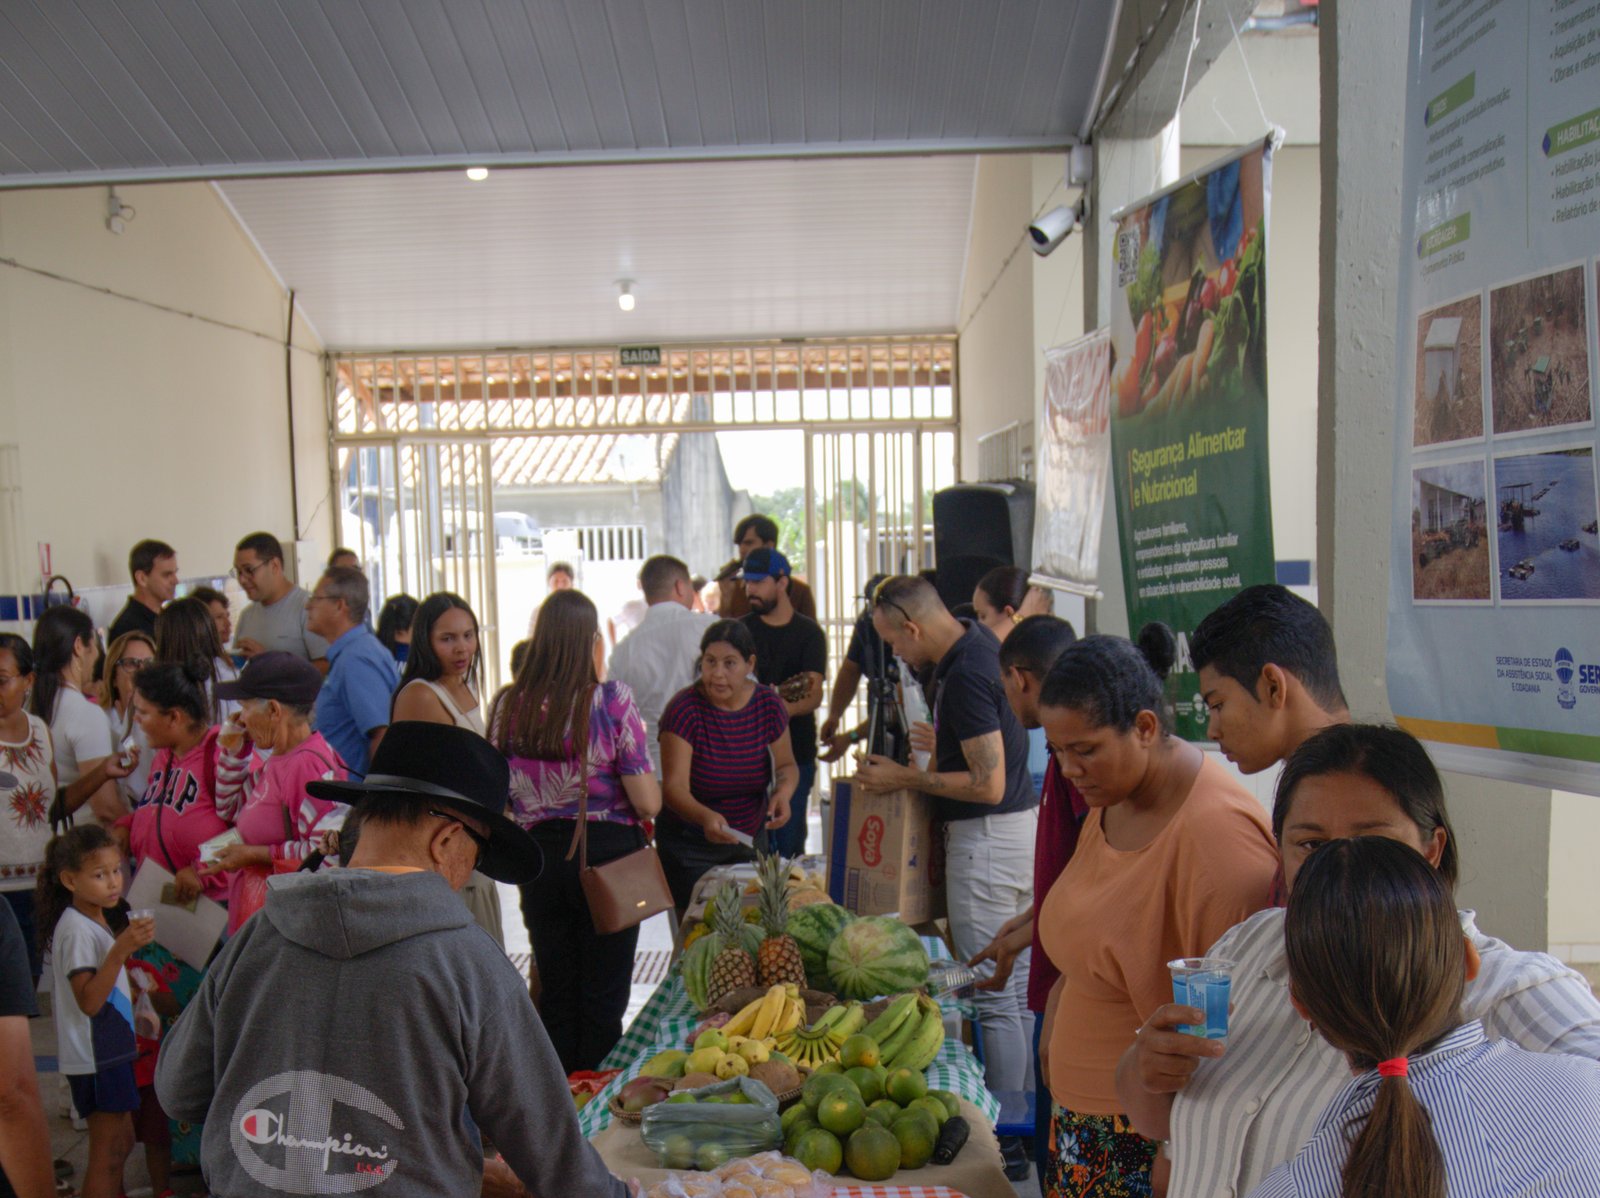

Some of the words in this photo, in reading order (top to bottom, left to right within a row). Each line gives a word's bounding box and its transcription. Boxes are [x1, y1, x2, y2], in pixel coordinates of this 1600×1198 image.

[1554, 62, 1574, 83] Obras
[1555, 153, 1593, 177] Habilitação
[1556, 175, 1594, 199] Habilitação
[1556, 200, 1588, 223] Relatório
[1131, 441, 1185, 477] Segurança
[1187, 426, 1247, 460] Alimentar
[1134, 490, 1141, 507] e
[1142, 469, 1198, 505] Nutricional
[1182, 537, 1216, 556] agricultura
[1216, 532, 1239, 548] familiar
[1200, 556, 1229, 575] pessoas
[1176, 575, 1222, 594] vulnerabilidade
[1222, 573, 1242, 589] social.
[1495, 656, 1523, 667] SECRETARIA
[1523, 657, 1531, 667] DE
[1532, 658, 1552, 668] ESTADO
[1496, 669, 1505, 678] DA
[1535, 671, 1554, 681] SOCIAL
[862, 818, 880, 863] Soya
[239, 1108, 388, 1172] Champion
